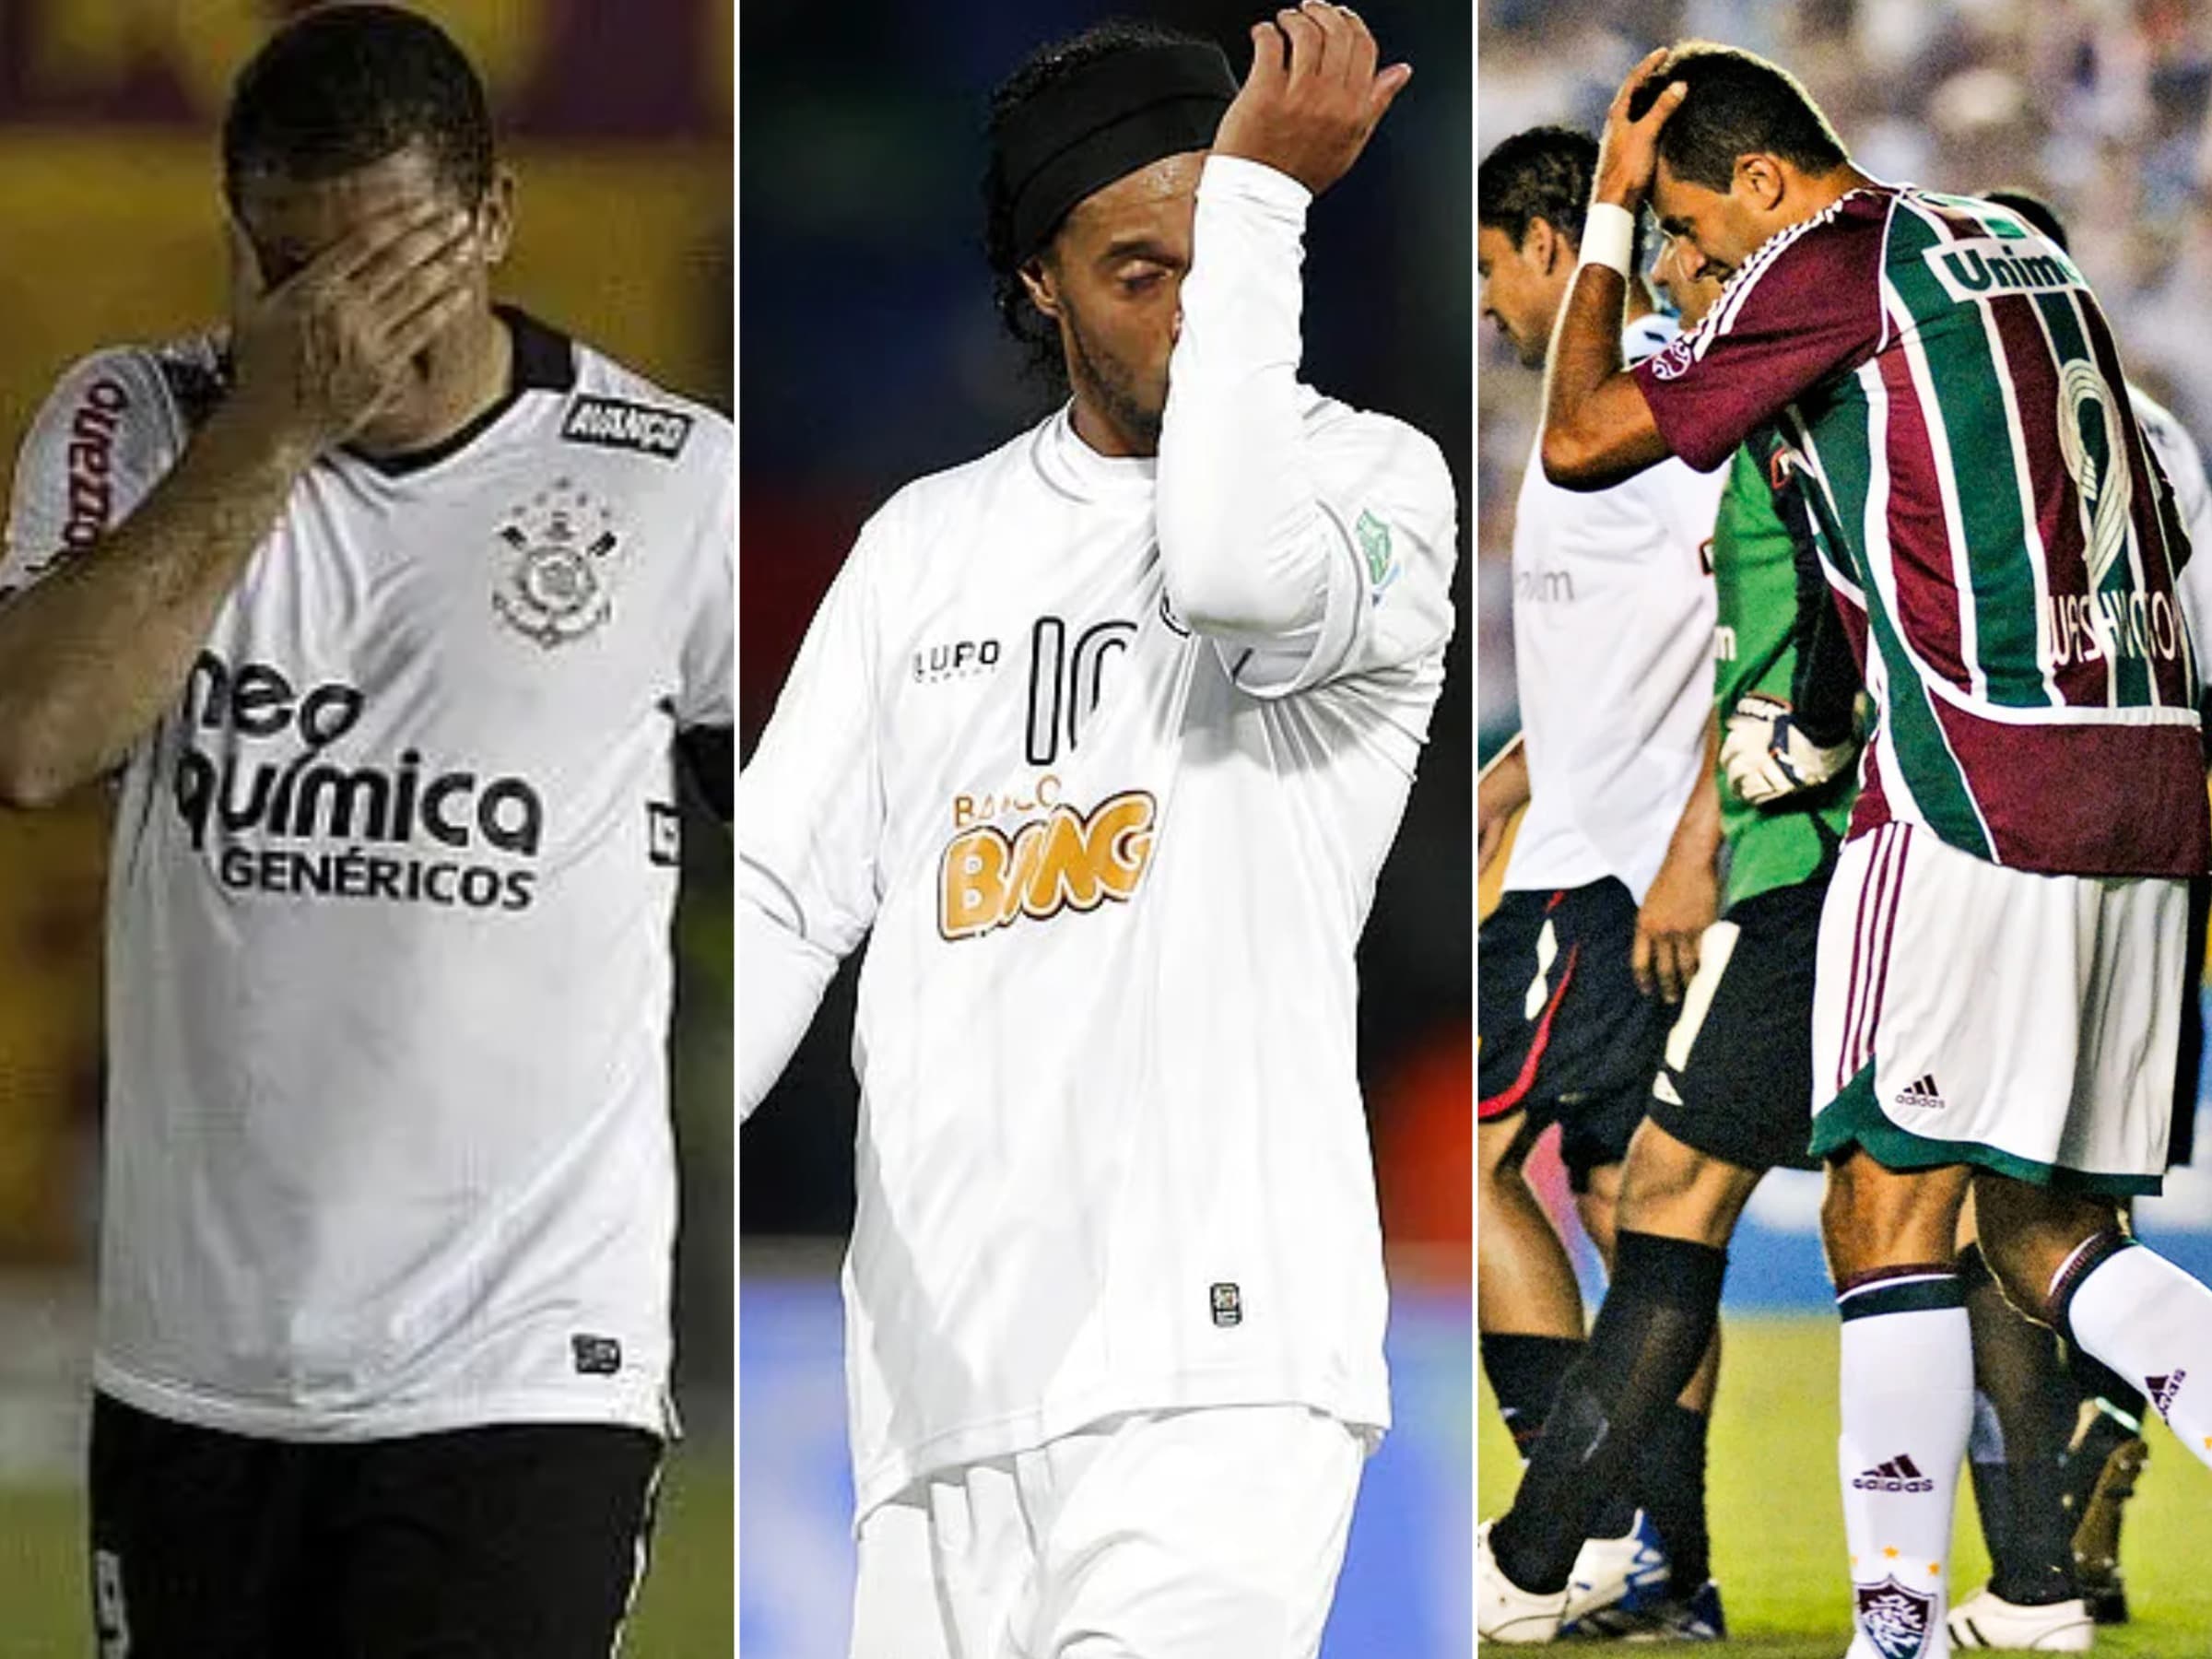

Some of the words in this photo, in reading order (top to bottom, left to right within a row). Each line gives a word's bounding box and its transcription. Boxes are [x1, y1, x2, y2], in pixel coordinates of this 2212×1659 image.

[62, 377, 129, 549] ozzano
[2057, 358, 2134, 590] 9
[186, 649, 365, 746] neo
[220, 846, 537, 912] GENÉRICOS
